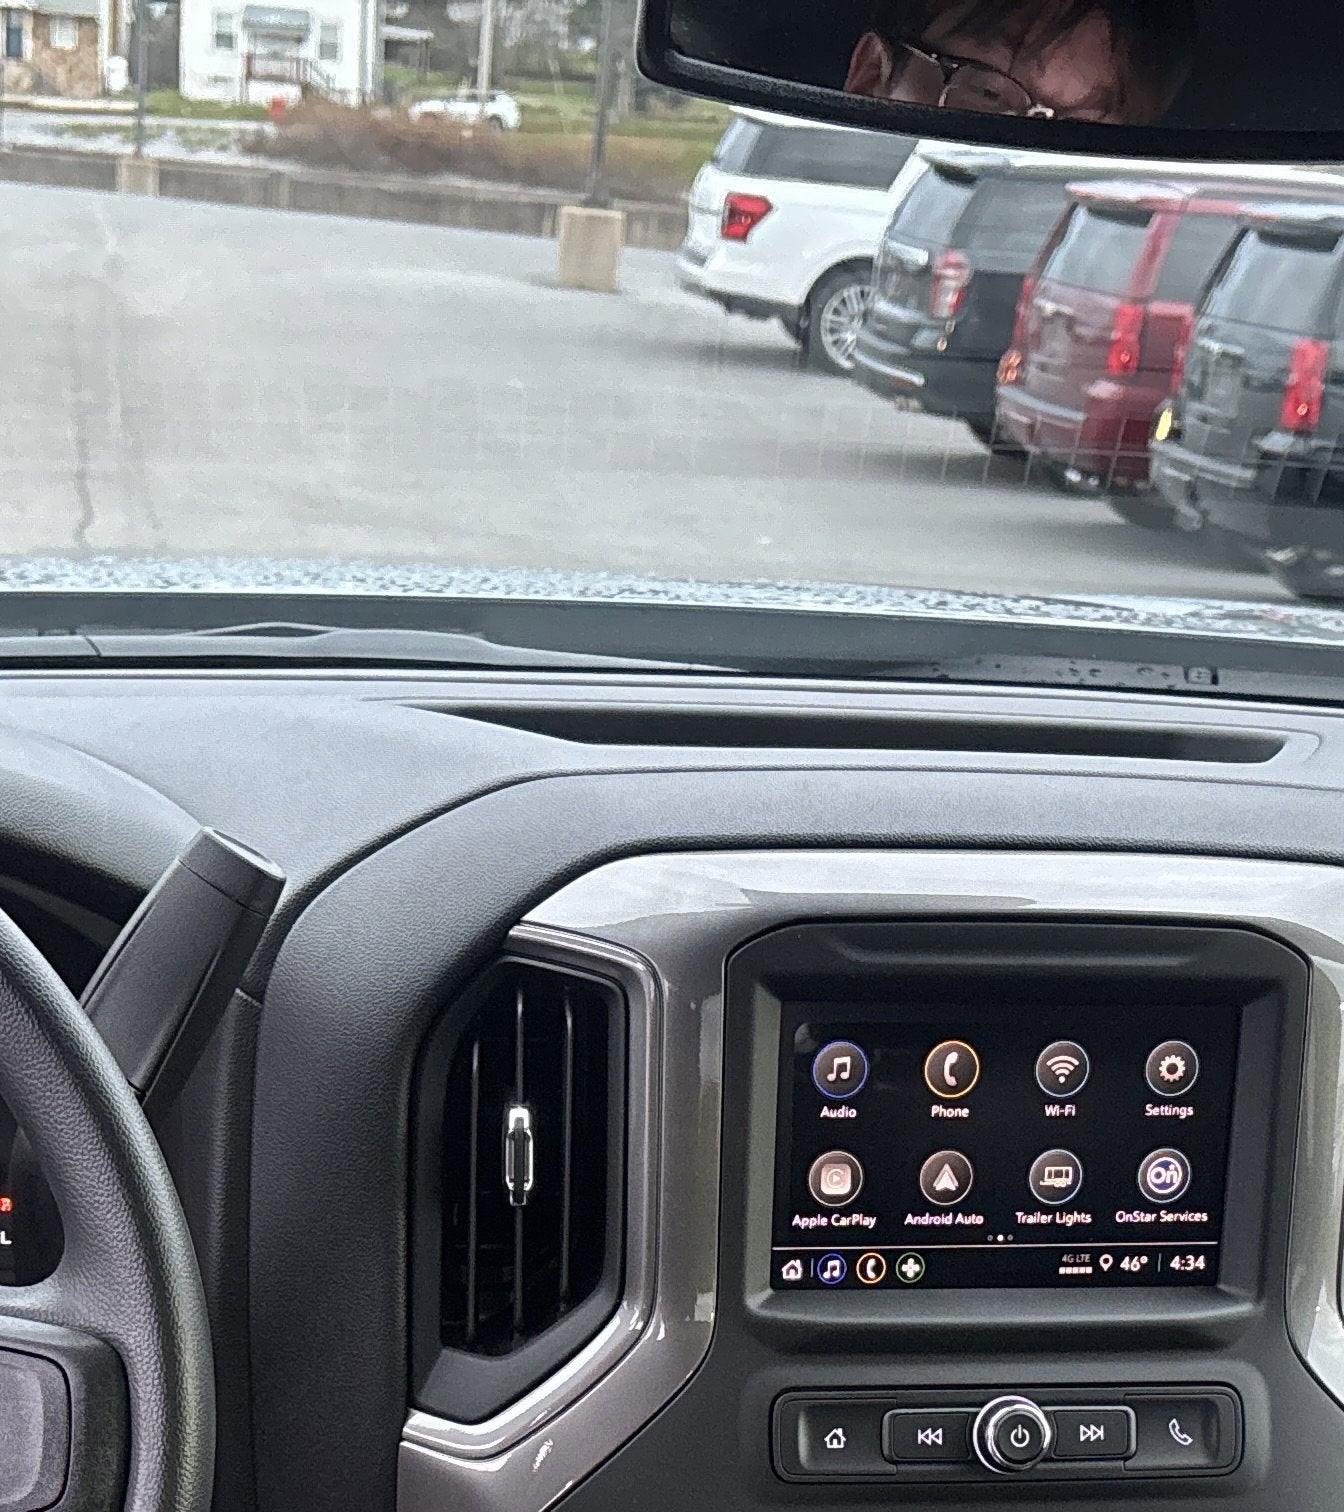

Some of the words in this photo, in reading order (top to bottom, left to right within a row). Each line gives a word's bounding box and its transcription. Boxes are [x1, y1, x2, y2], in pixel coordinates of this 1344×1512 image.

[820, 1106, 856, 1118] Audio
[931, 1105, 969, 1118] Phone
[1045, 1104, 1076, 1116] Wi-Fi
[1145, 1103, 1194, 1119] Settings
[792, 1214, 828, 1229] Apple
[831, 1213, 876, 1228] CarPlay
[904, 1212, 952, 1225] Android
[955, 1213, 984, 1225] Auto
[1015, 1211, 1053, 1224] Trailer
[1056, 1211, 1092, 1226] Lights
[1115, 1211, 1157, 1223] OnStar
[1159, 1210, 1208, 1222] Services
[0, 1230, 12, 1245] L
[1062, 1254, 1074, 1263] 4G
[1076, 1254, 1091, 1263] LTE
[1120, 1255, 1148, 1272] 46°
[1169, 1254, 1206, 1270] 4:34
